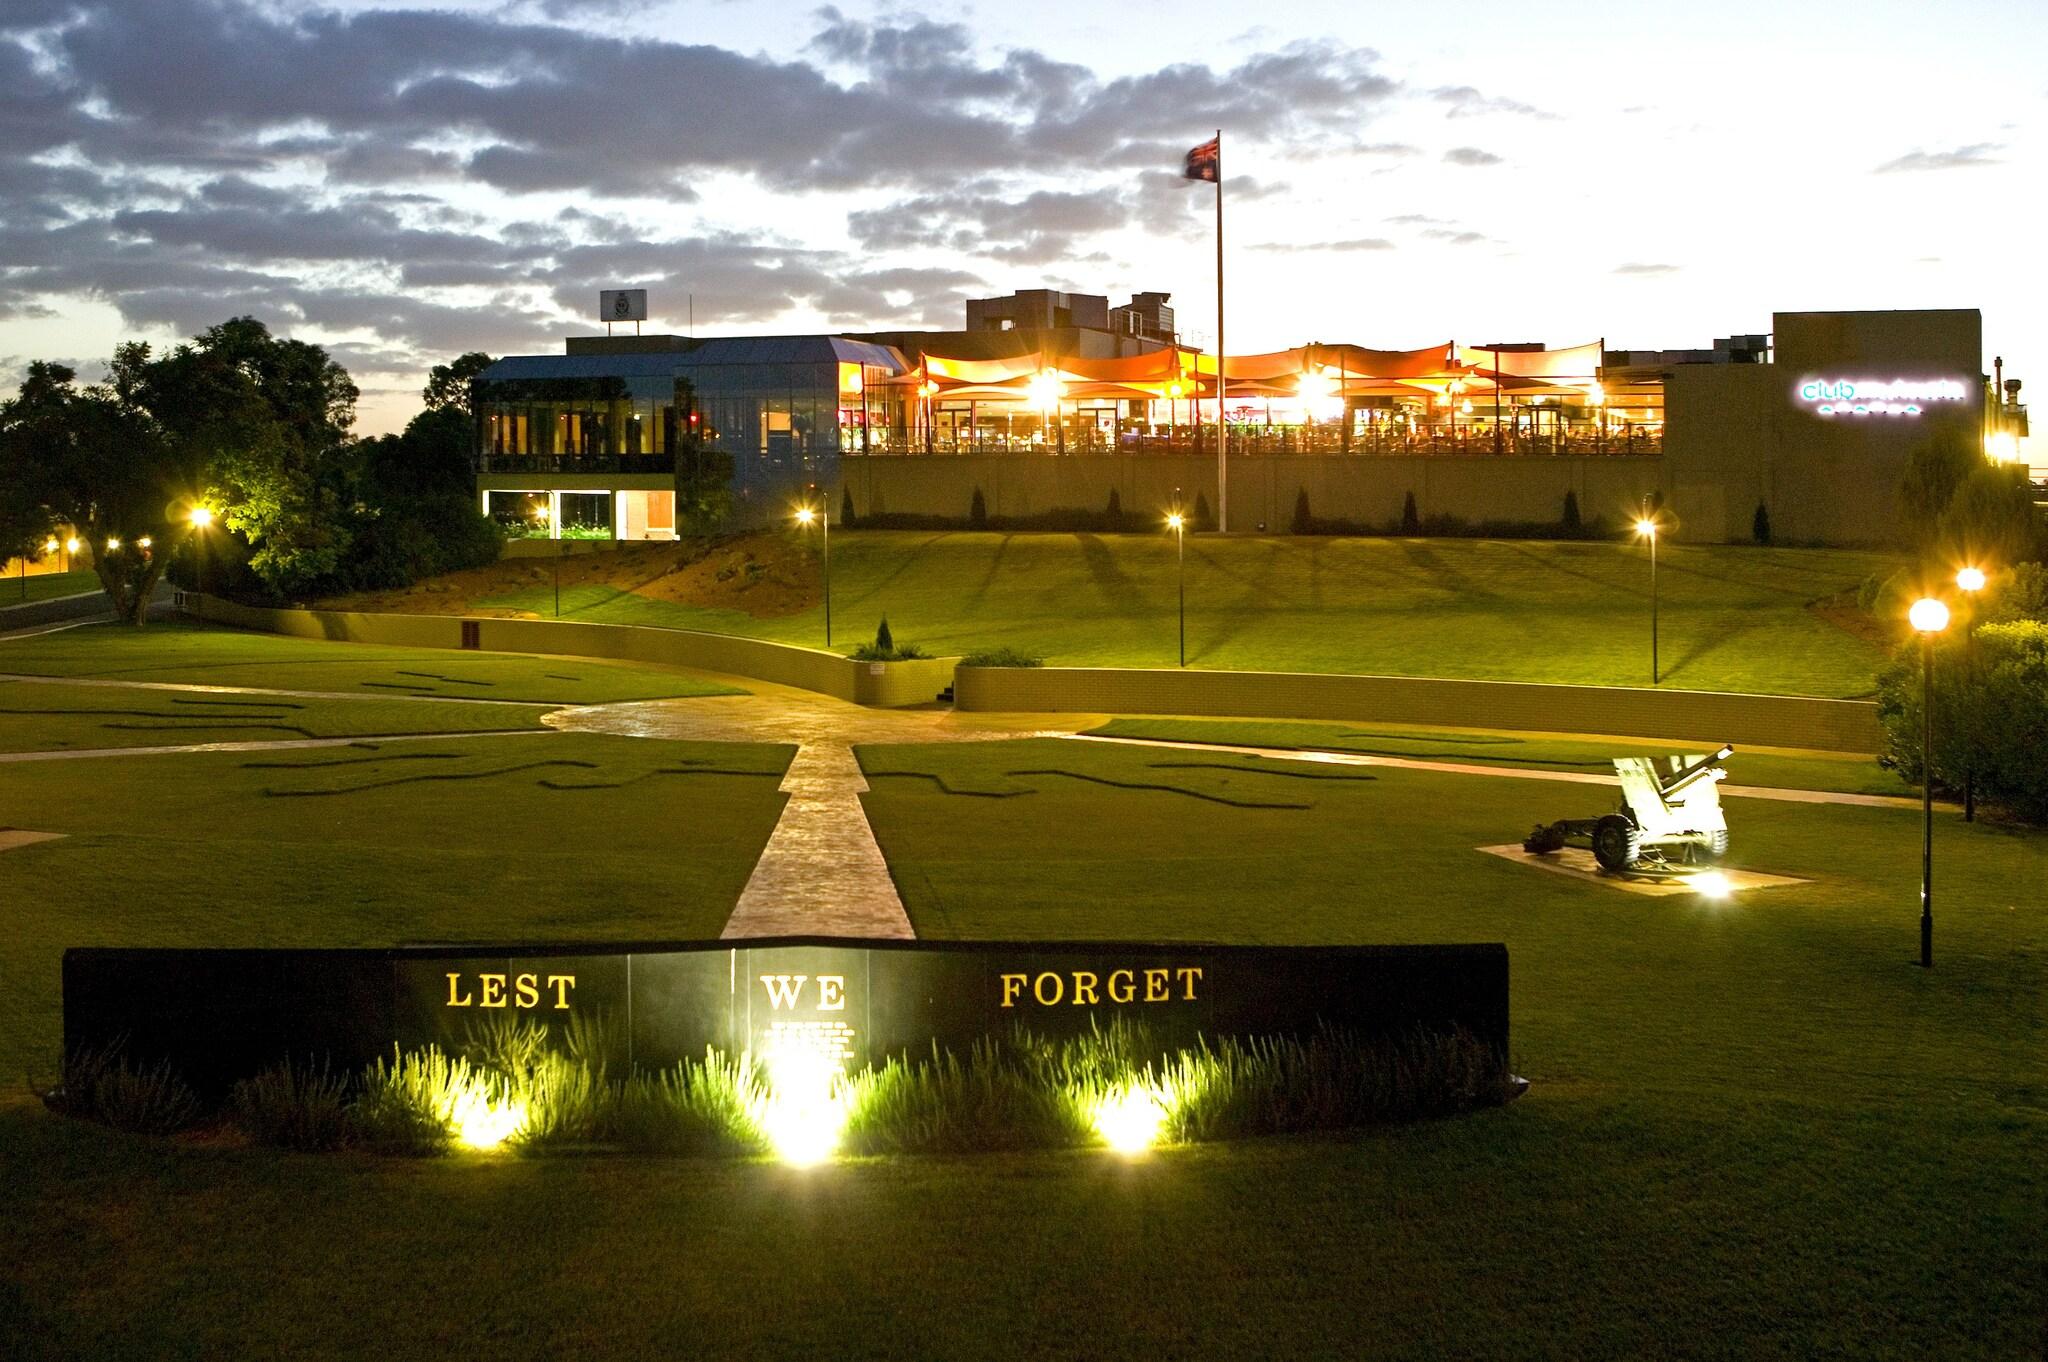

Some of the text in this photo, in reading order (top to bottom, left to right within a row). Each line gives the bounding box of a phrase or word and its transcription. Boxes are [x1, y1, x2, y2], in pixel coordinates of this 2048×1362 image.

[1802, 381, 1855, 400] club
[445, 967, 1203, 1011] LEST WE FORGET
